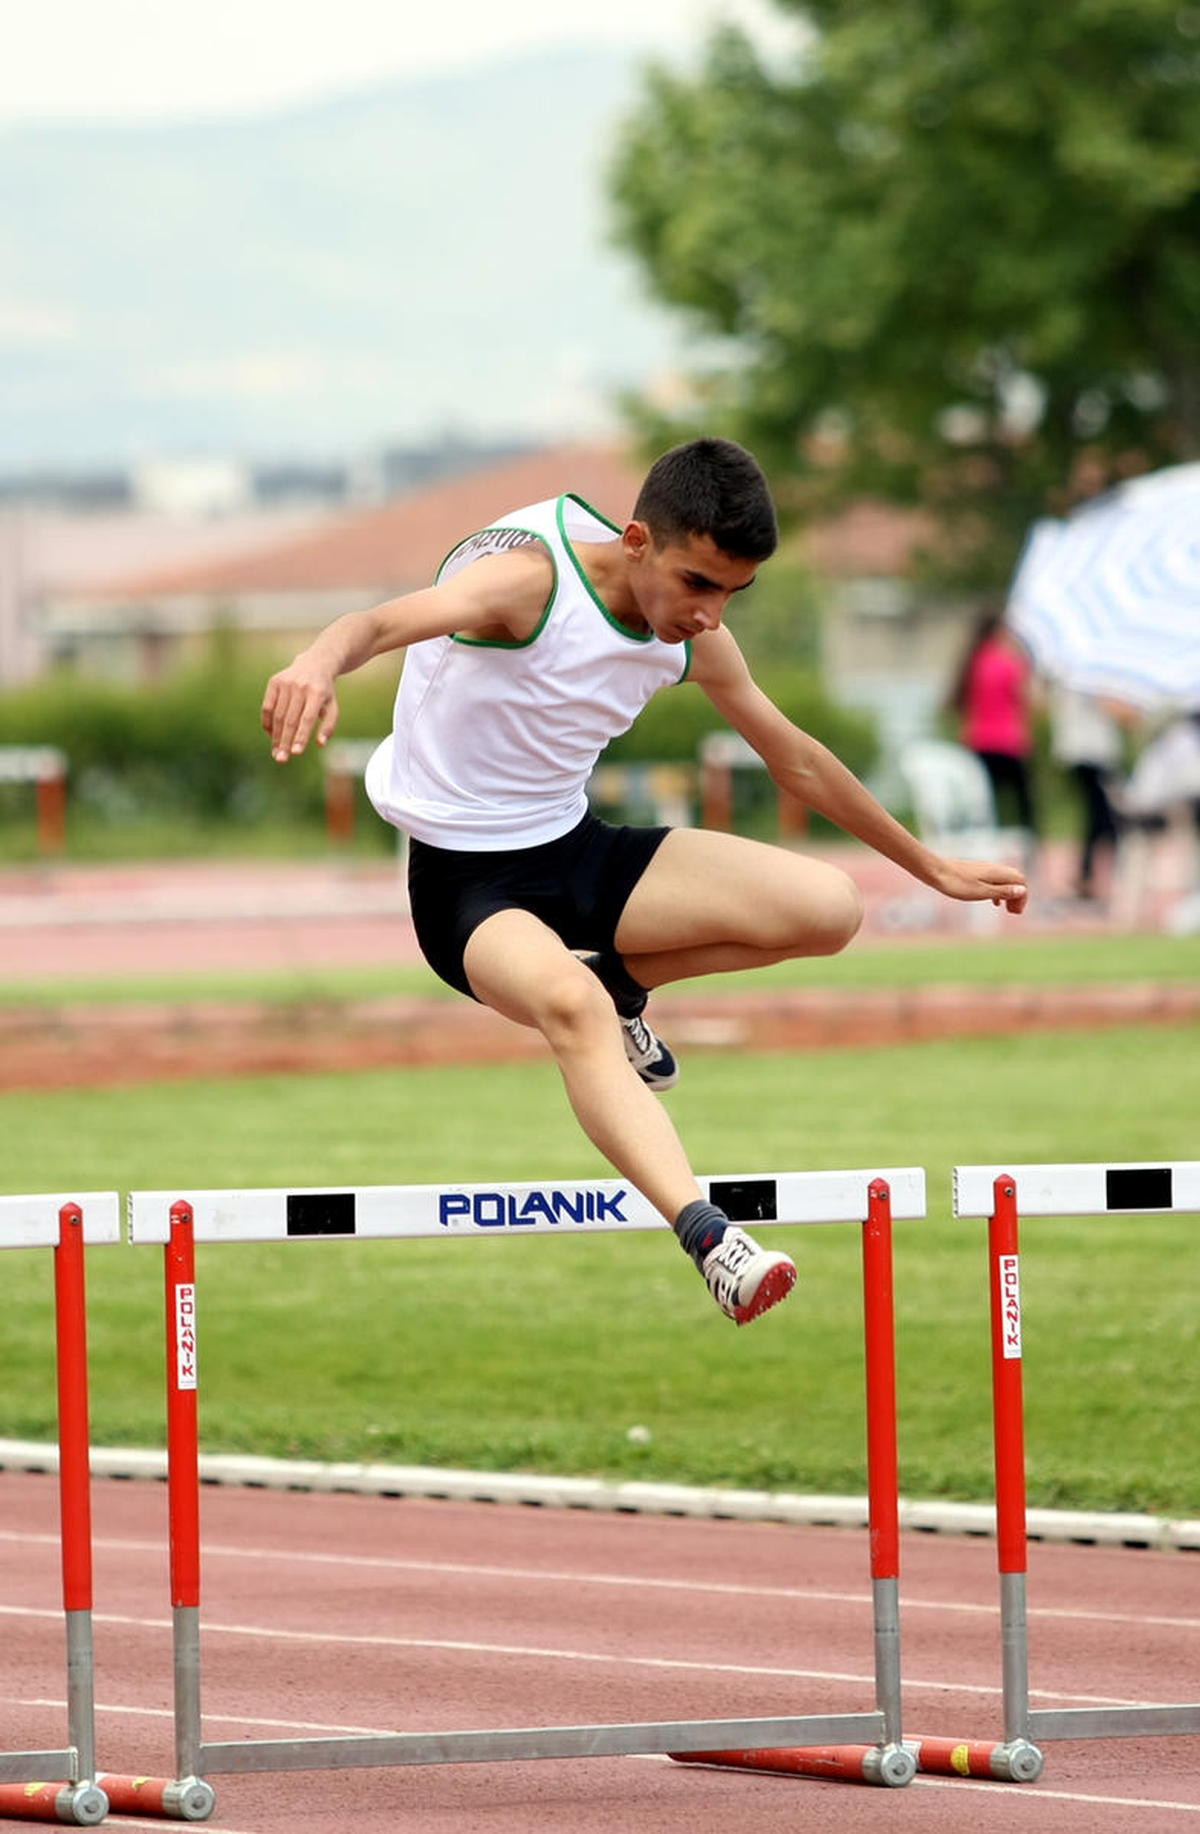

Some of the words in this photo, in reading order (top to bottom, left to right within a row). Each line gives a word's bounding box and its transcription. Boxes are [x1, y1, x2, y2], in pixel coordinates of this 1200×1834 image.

[439, 1190, 628, 1227] POLANIK
[180, 1287, 195, 1377] POLANIK
[1003, 1259, 1019, 1346] POLANIK
